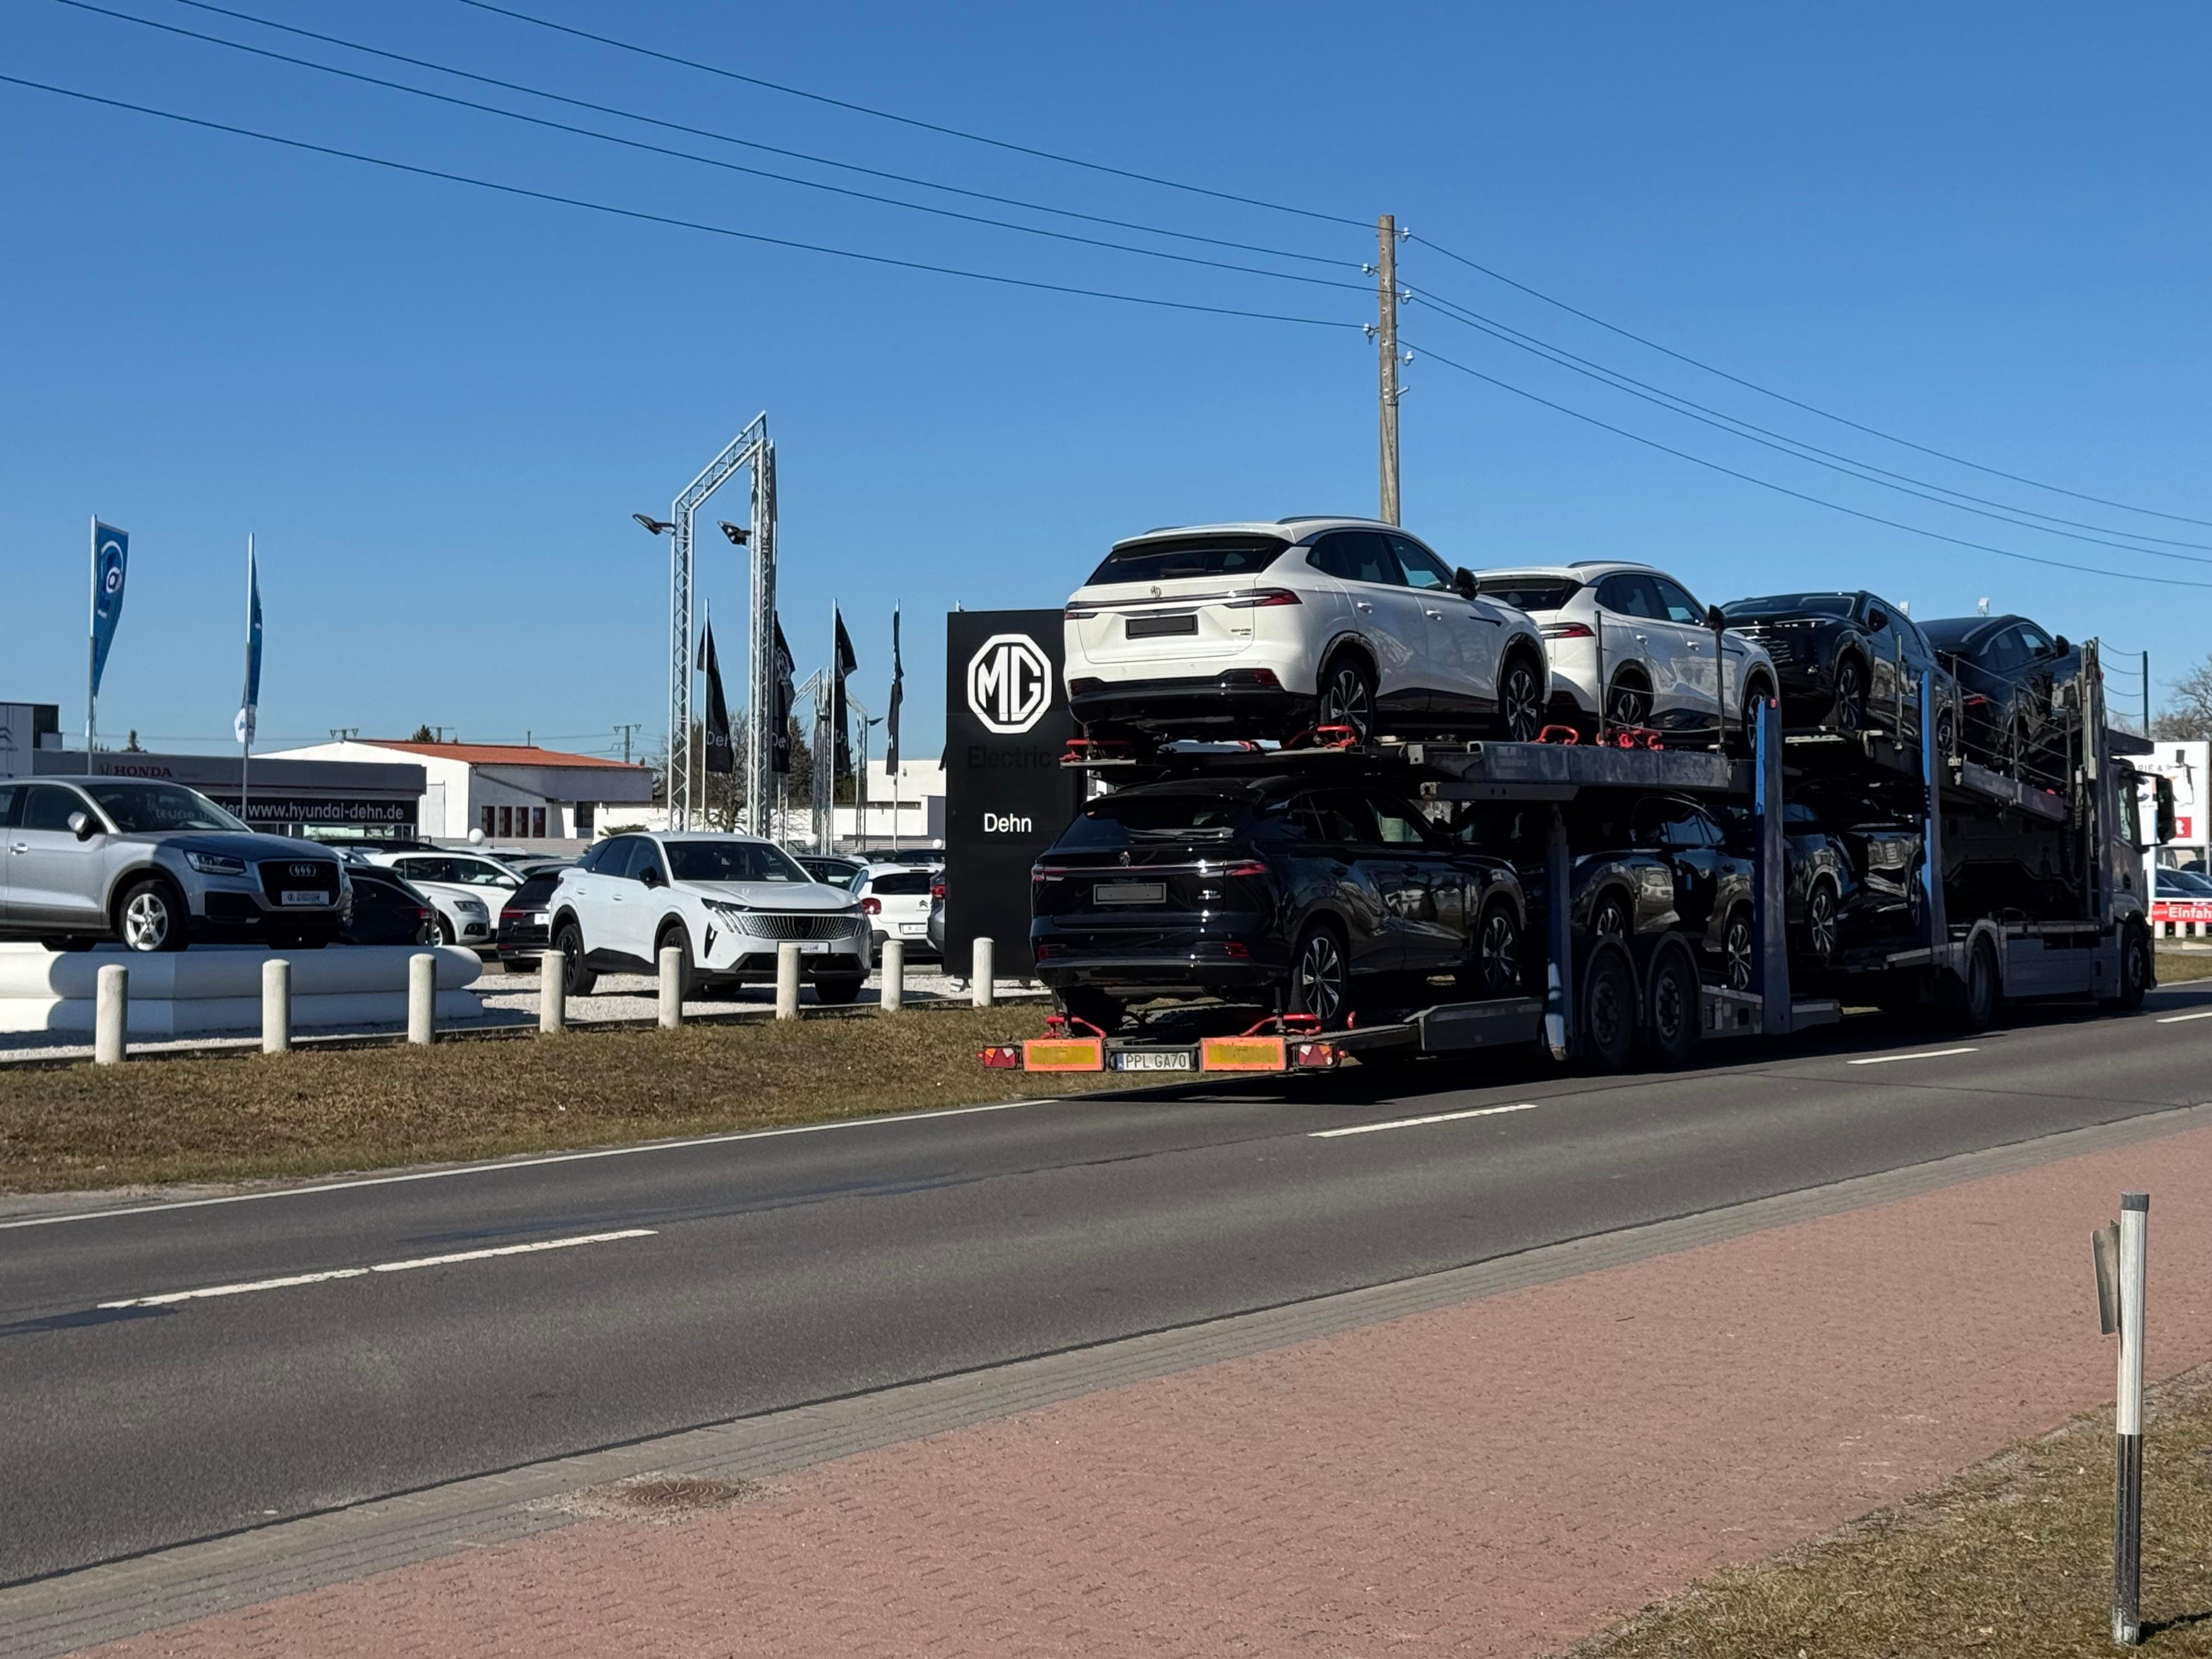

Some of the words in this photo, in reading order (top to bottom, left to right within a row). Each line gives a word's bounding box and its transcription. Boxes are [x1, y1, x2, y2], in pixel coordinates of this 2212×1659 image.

[978, 646, 1042, 721] MG
[967, 745, 1052, 768] Electric
[114, 765, 173, 777] HONDA
[248, 802, 404, 821] www.hyundai-dehn.de
[984, 813, 1032, 832] Dehn
[1126, 1054, 1150, 1068] PPL
[1155, 1054, 1186, 1068] GA70
